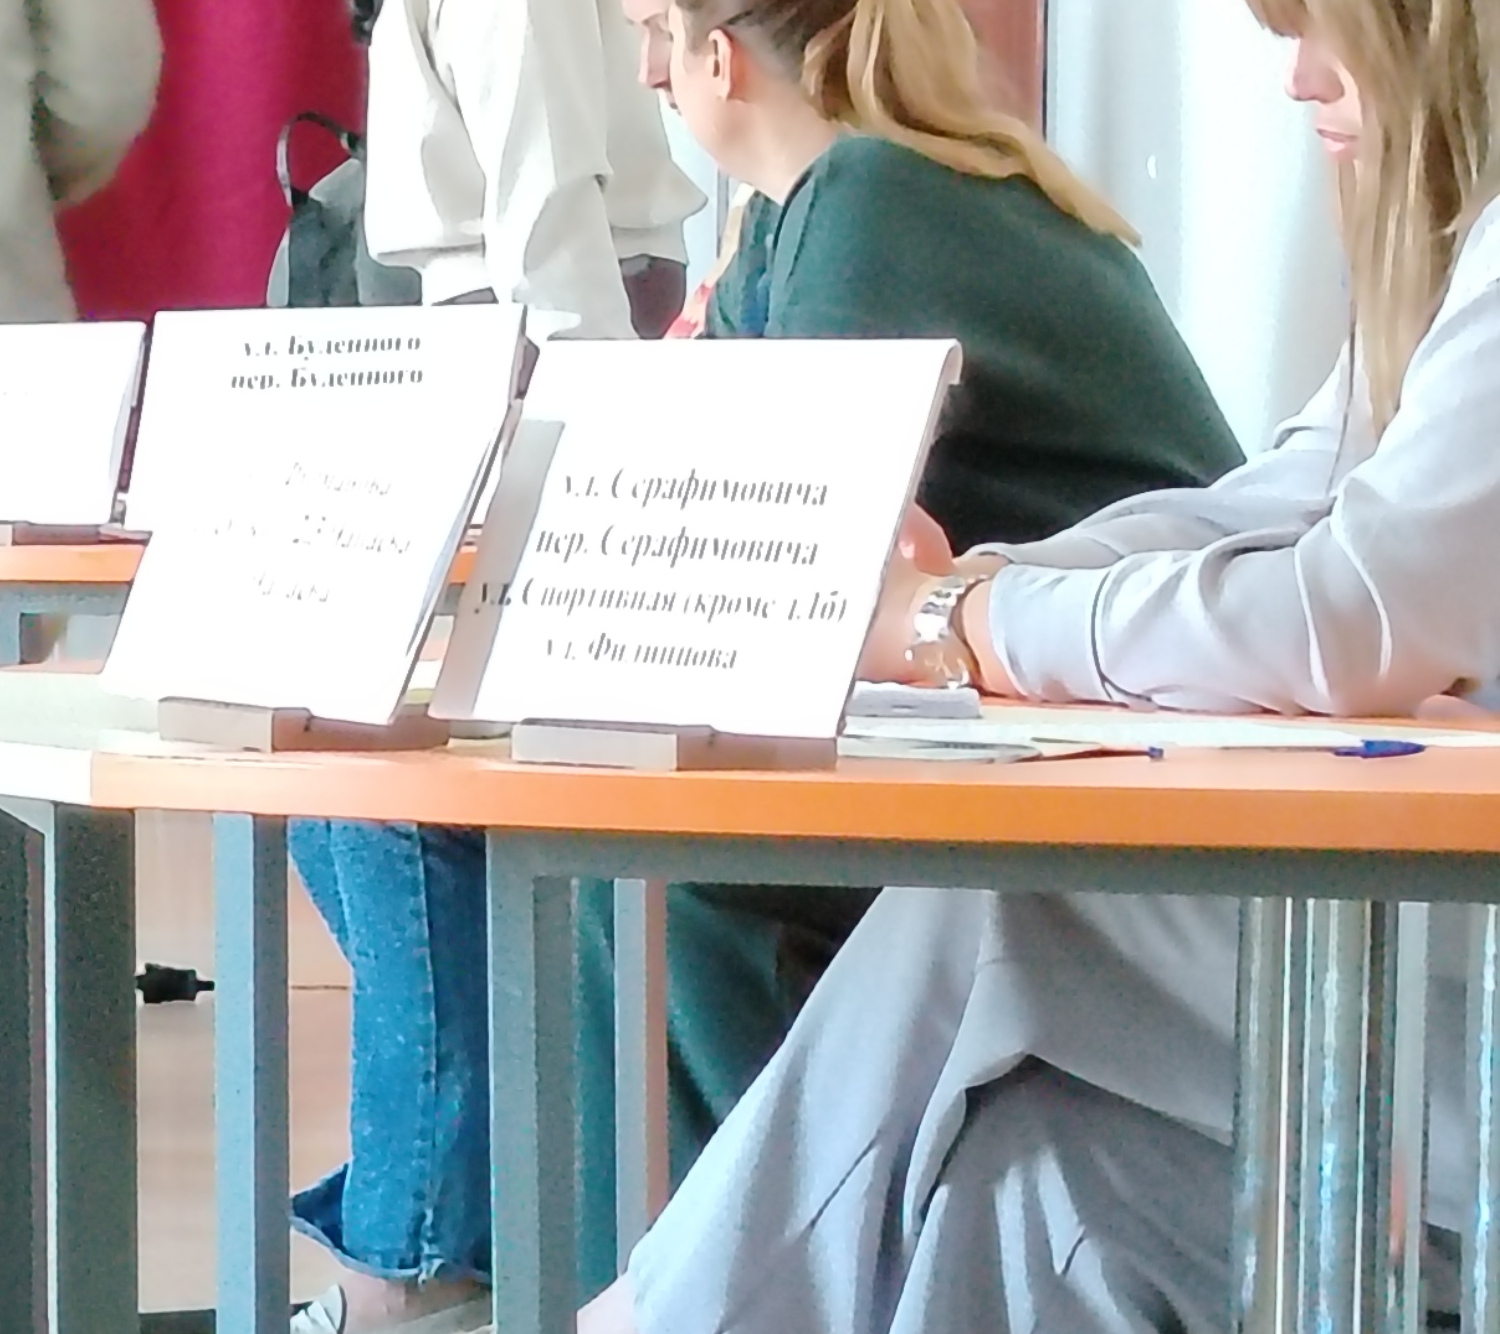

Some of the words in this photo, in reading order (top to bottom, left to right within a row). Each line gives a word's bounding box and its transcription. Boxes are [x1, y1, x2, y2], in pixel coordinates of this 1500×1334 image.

[610, 467, 828, 511] Серафимовича
[536, 530, 588, 564] пер.
[600, 524, 819, 569] Серафимовича
[521, 577, 677, 617] Спортивная
[683, 593, 777, 624] (кроме
